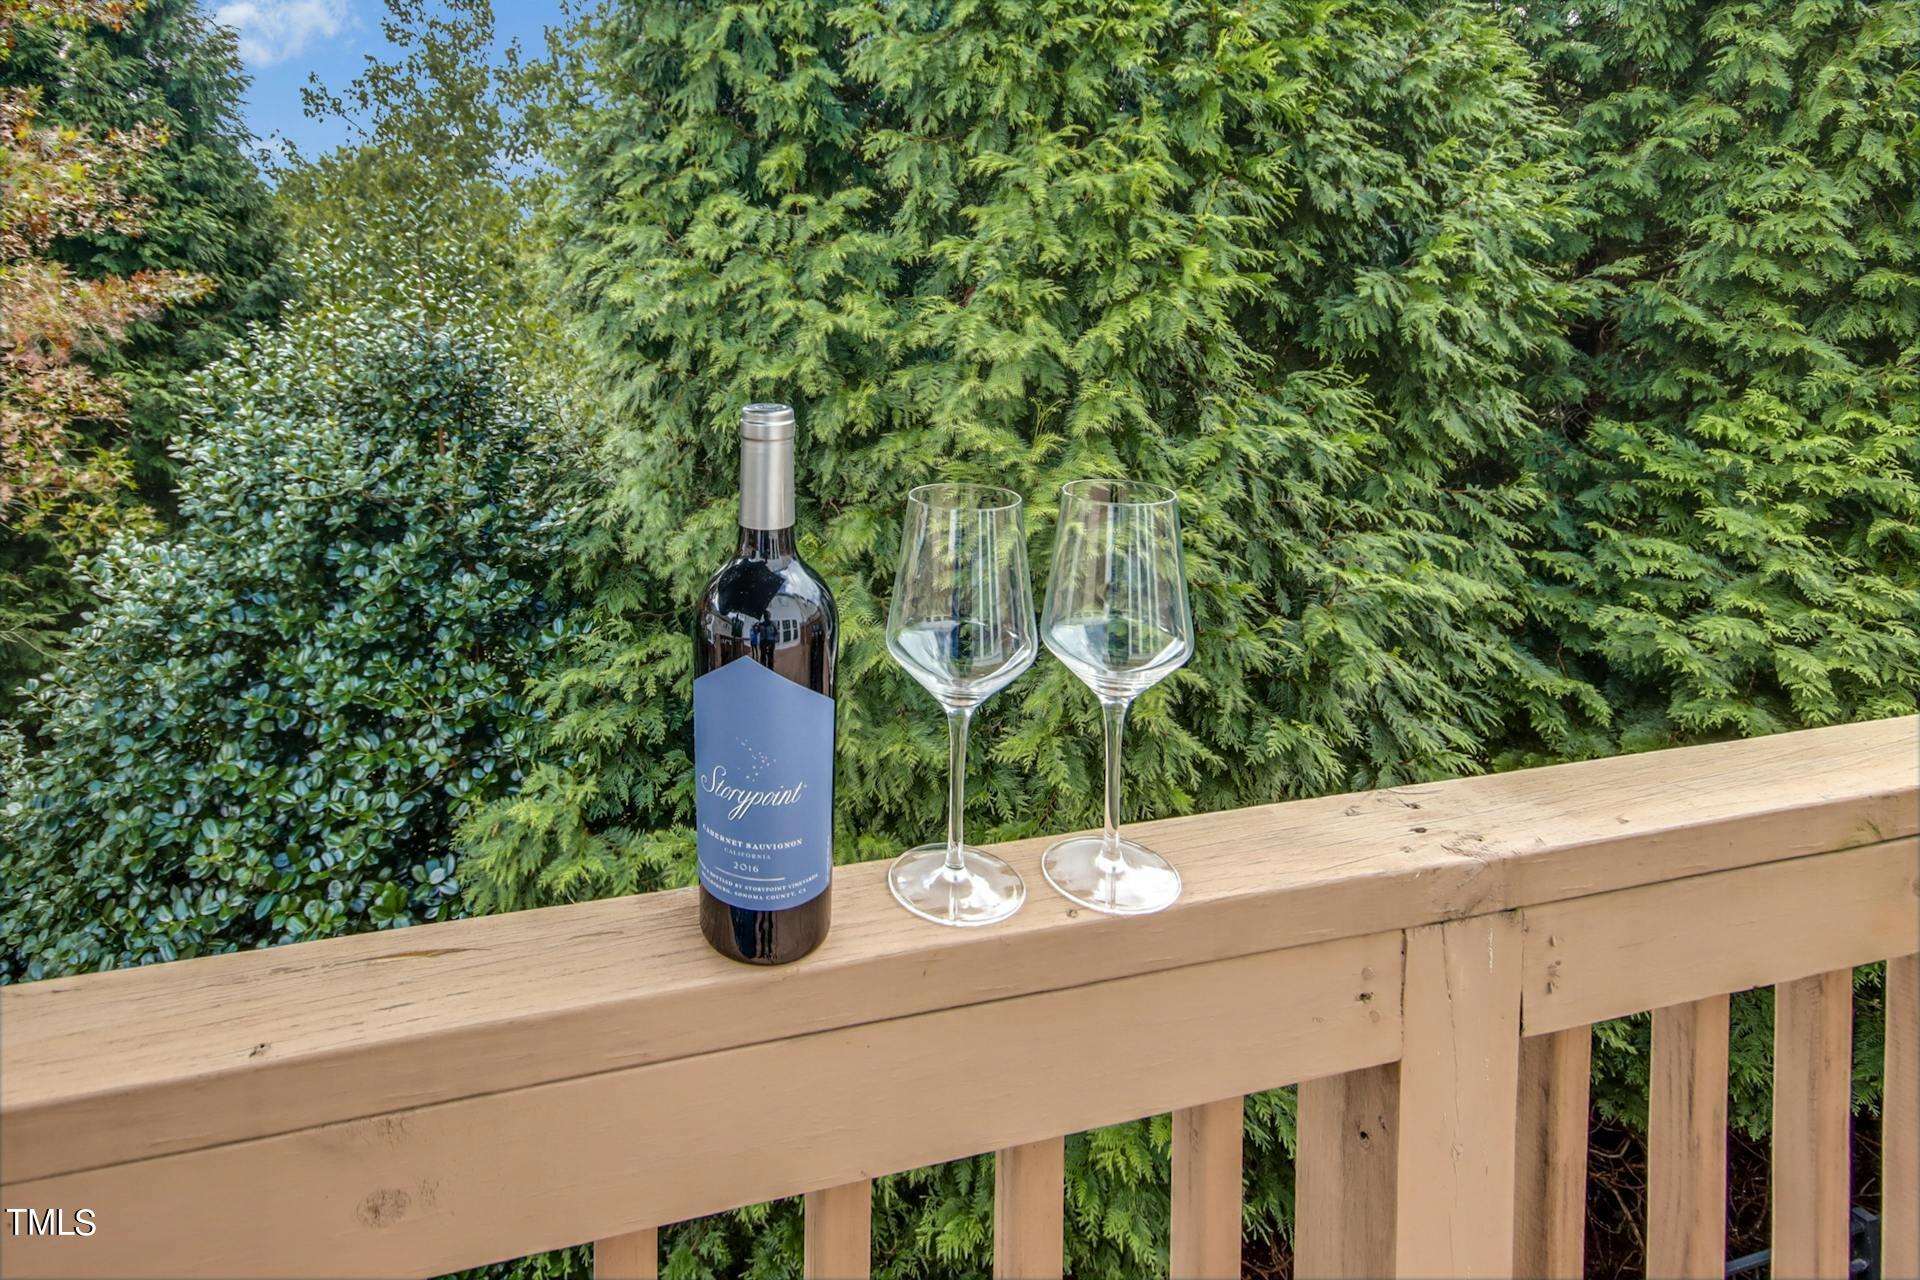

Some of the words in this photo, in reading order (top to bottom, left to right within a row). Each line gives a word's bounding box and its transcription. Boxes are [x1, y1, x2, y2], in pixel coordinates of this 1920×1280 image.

[700, 765, 804, 821] Storypoint
[702, 823, 743, 848] CABERNET
[745, 838, 803, 851] SAUVIGNON
[723, 847, 771, 860] CALIFORNIA
[733, 861, 760, 873] 2016
[744, 885, 785, 893] STORYPOINT
[734, 891, 763, 901] SONOMA
